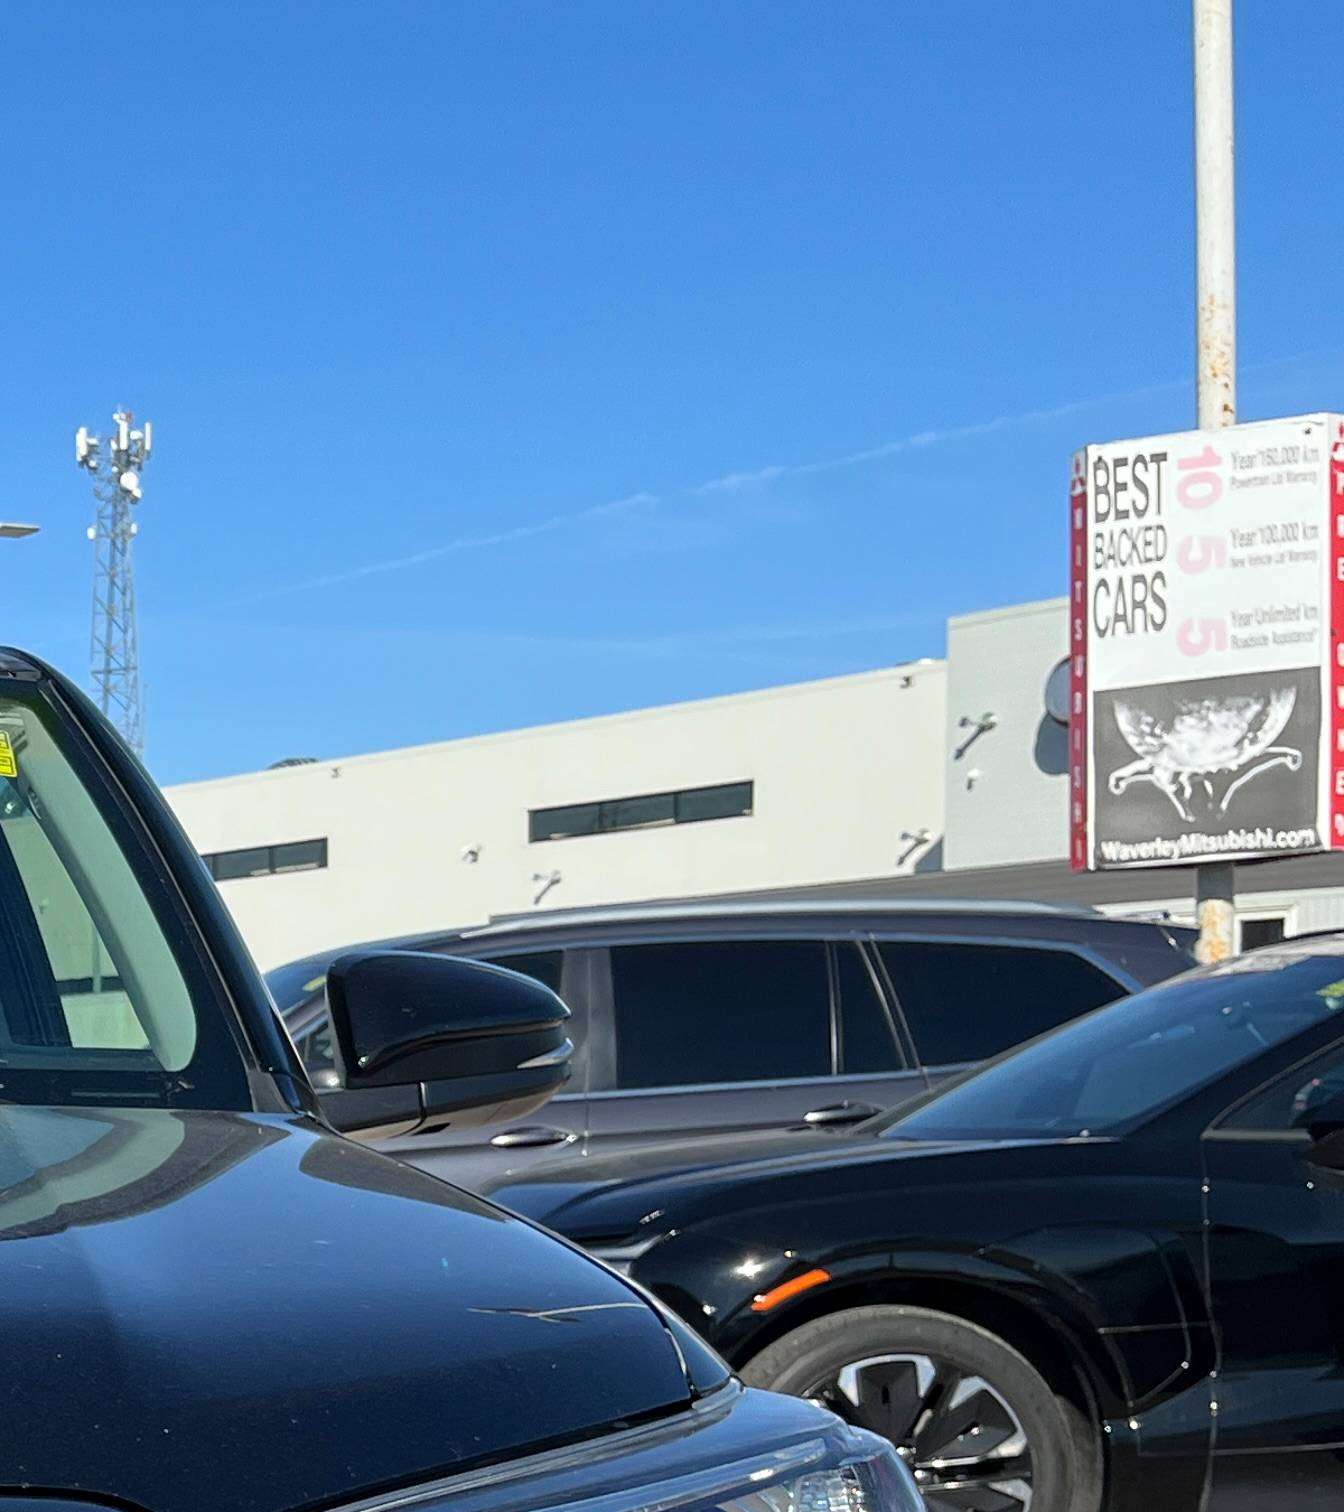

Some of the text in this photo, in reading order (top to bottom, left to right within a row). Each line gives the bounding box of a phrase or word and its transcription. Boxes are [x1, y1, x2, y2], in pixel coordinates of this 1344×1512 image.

[1093, 452, 1168, 523] BEST
[1176, 445, 1223, 510] 10
[1094, 525, 1168, 570] BACKED
[1093, 570, 1167, 638] CARS
[1101, 828, 1316, 861] WaverleyMitsubishi.com
